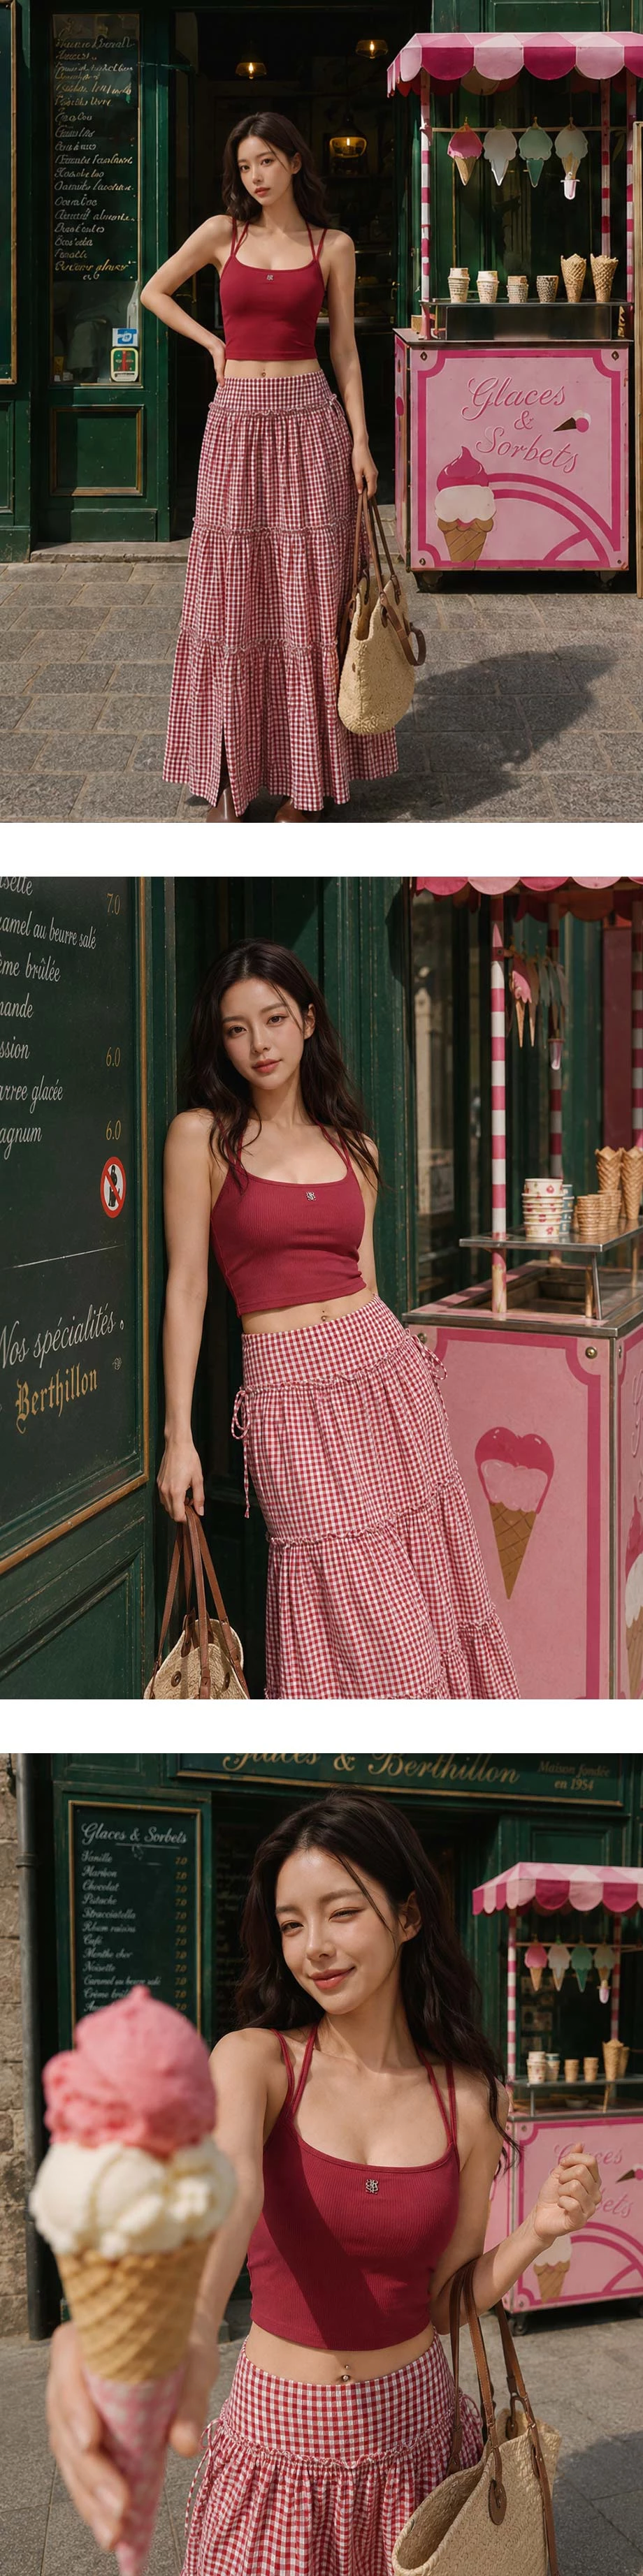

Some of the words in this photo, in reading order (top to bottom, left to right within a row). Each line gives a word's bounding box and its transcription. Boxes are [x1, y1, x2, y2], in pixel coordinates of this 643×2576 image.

[461, 376, 565, 421] Glaces
[514, 410, 534, 430] &
[475, 427, 579, 474] Sorbets
[106, 893, 120, 915] 7.0
[0, 911, 32, 936] amel
[33, 923, 47, 939] au
[49, 916, 78, 946] beurre
[78, 925, 96, 949] salé
[25, 952, 61, 982] brûlée
[106, 1047, 121, 1067] 6.0
[29, 1075, 64, 1114] glacée
[106, 1120, 122, 1141] 6.0
[0, 1321, 29, 1369] Nos
[15, 1363, 98, 1434] Berthillon
[333, 1753, 356, 1771] &
[368, 1753, 521, 1784] Berthillon
[81, 1822, 127, 1845] Glaces
[129, 1827, 140, 1842] &
